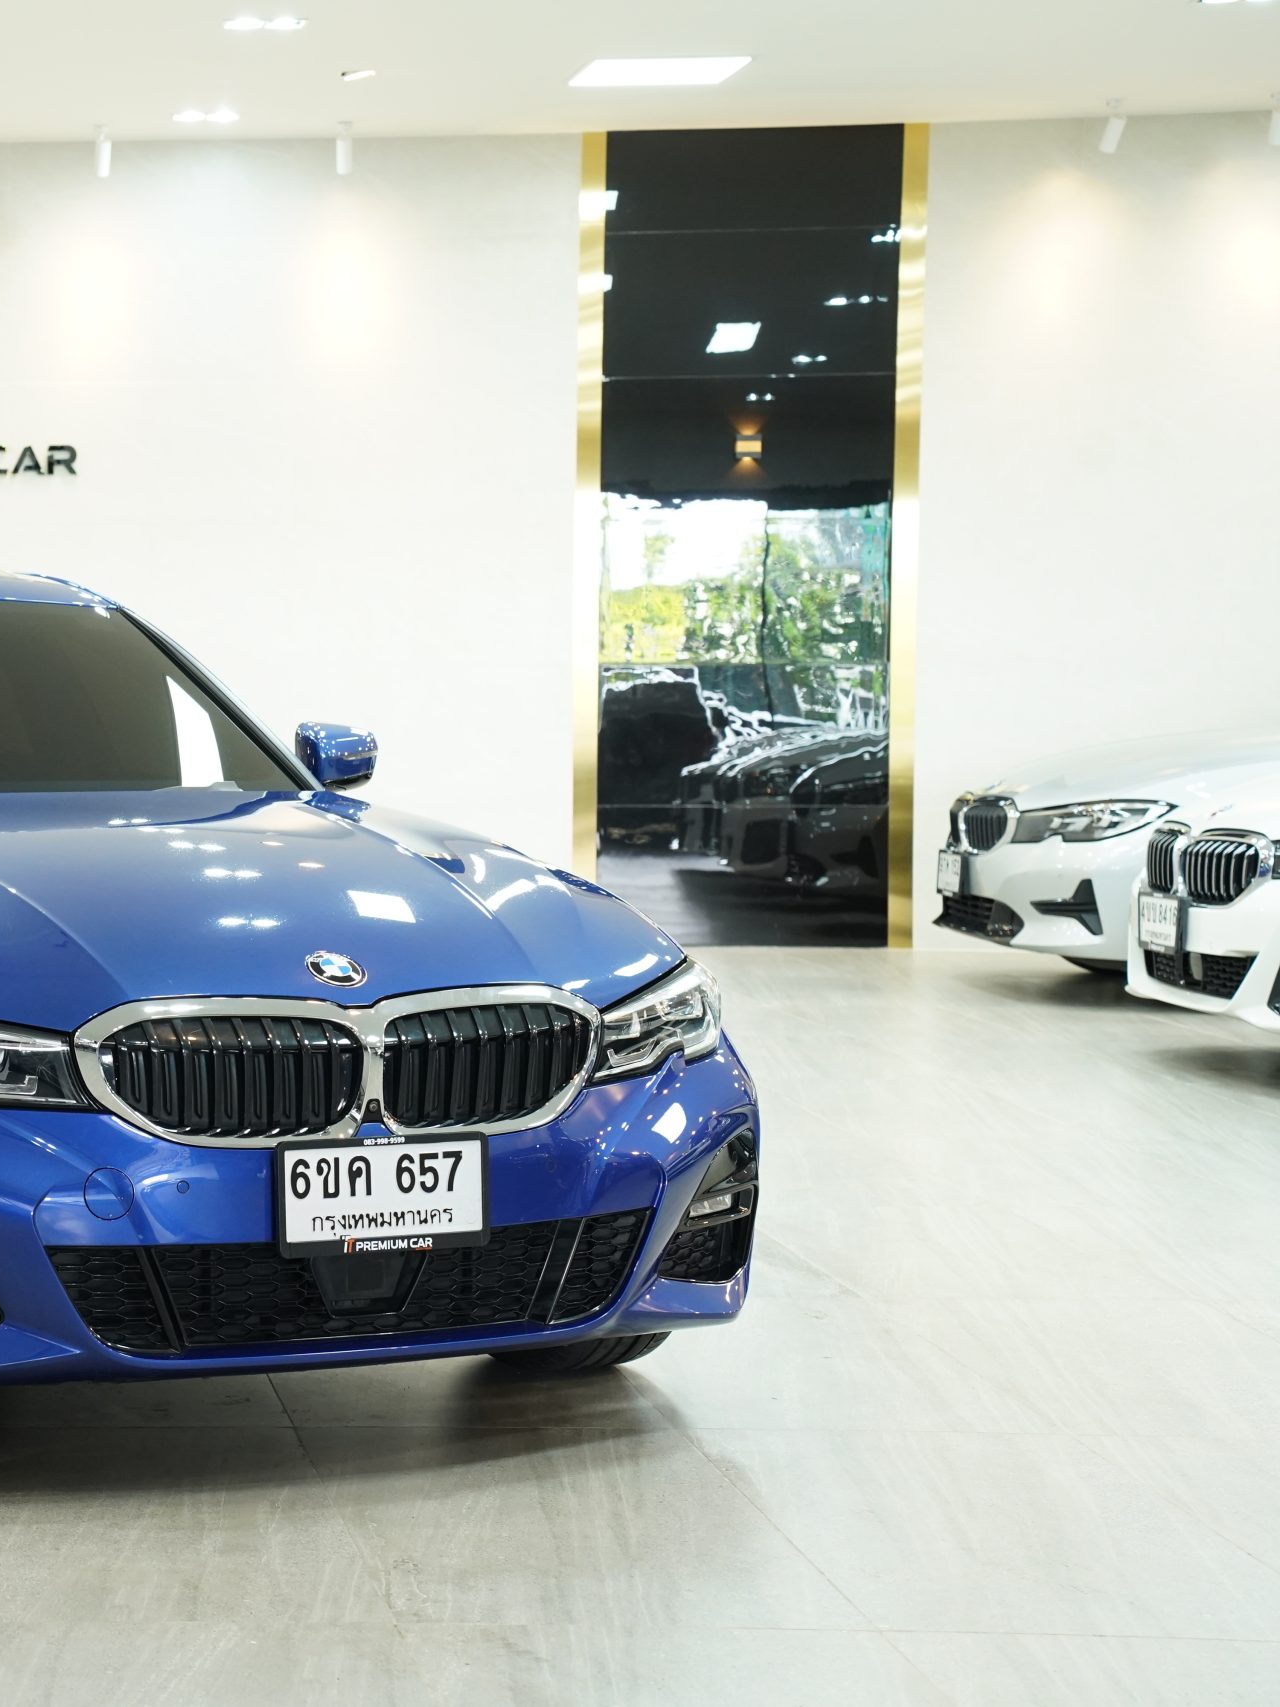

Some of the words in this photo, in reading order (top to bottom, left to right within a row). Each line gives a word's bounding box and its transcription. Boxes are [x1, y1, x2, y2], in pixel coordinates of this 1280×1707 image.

[363, 1136, 405, 1146] 083-998-9599
[290, 1155, 372, 1199] 6ขค
[396, 1150, 463, 1194] 657
[312, 1208, 453, 1236] กรุงเทพมหานคร
[355, 1239, 408, 1252] PREMIUM
[409, 1237, 433, 1248] CAR
